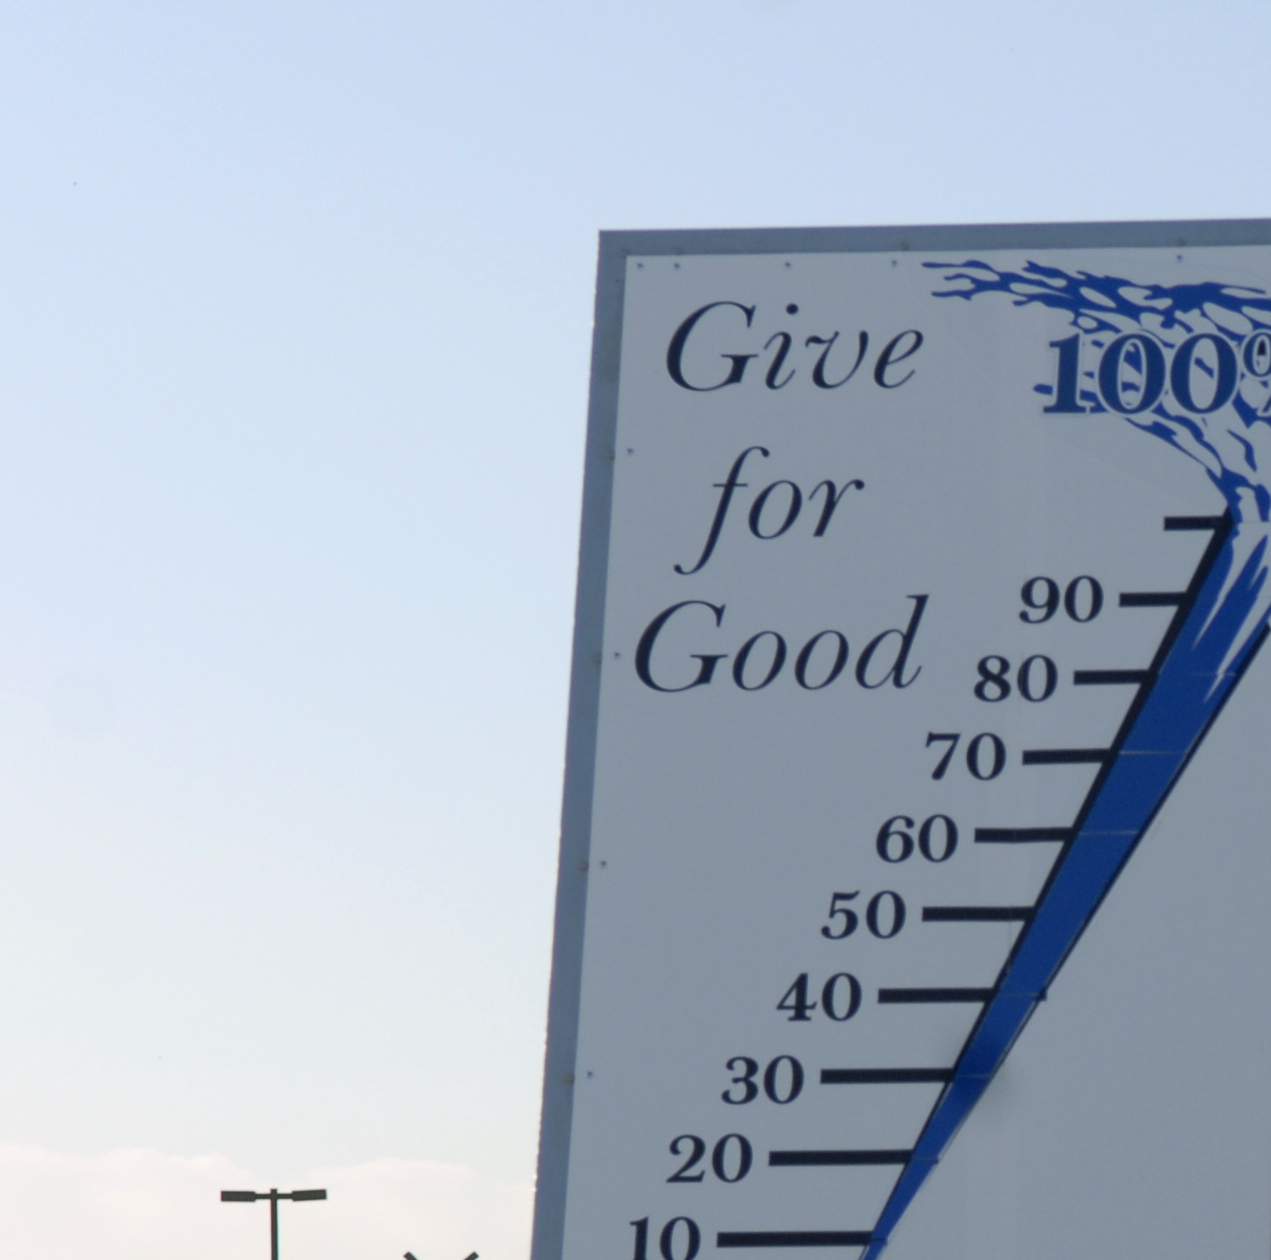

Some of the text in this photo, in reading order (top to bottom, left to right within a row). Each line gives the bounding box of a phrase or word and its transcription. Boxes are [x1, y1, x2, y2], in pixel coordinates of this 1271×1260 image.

[666, 301, 925, 392] Give
[673, 446, 866, 575] for
[1018, 575, 1104, 624] 90
[634, 594, 930, 693] Good
[973, 654, 1058, 703] 80
[925, 731, 1007, 781] 70
[875, 814, 959, 864] 60
[820, 890, 907, 940] 50
[776, 972, 862, 1022] 40
[721, 1054, 805, 1105] 30
[666, 1133, 753, 1184] 20
